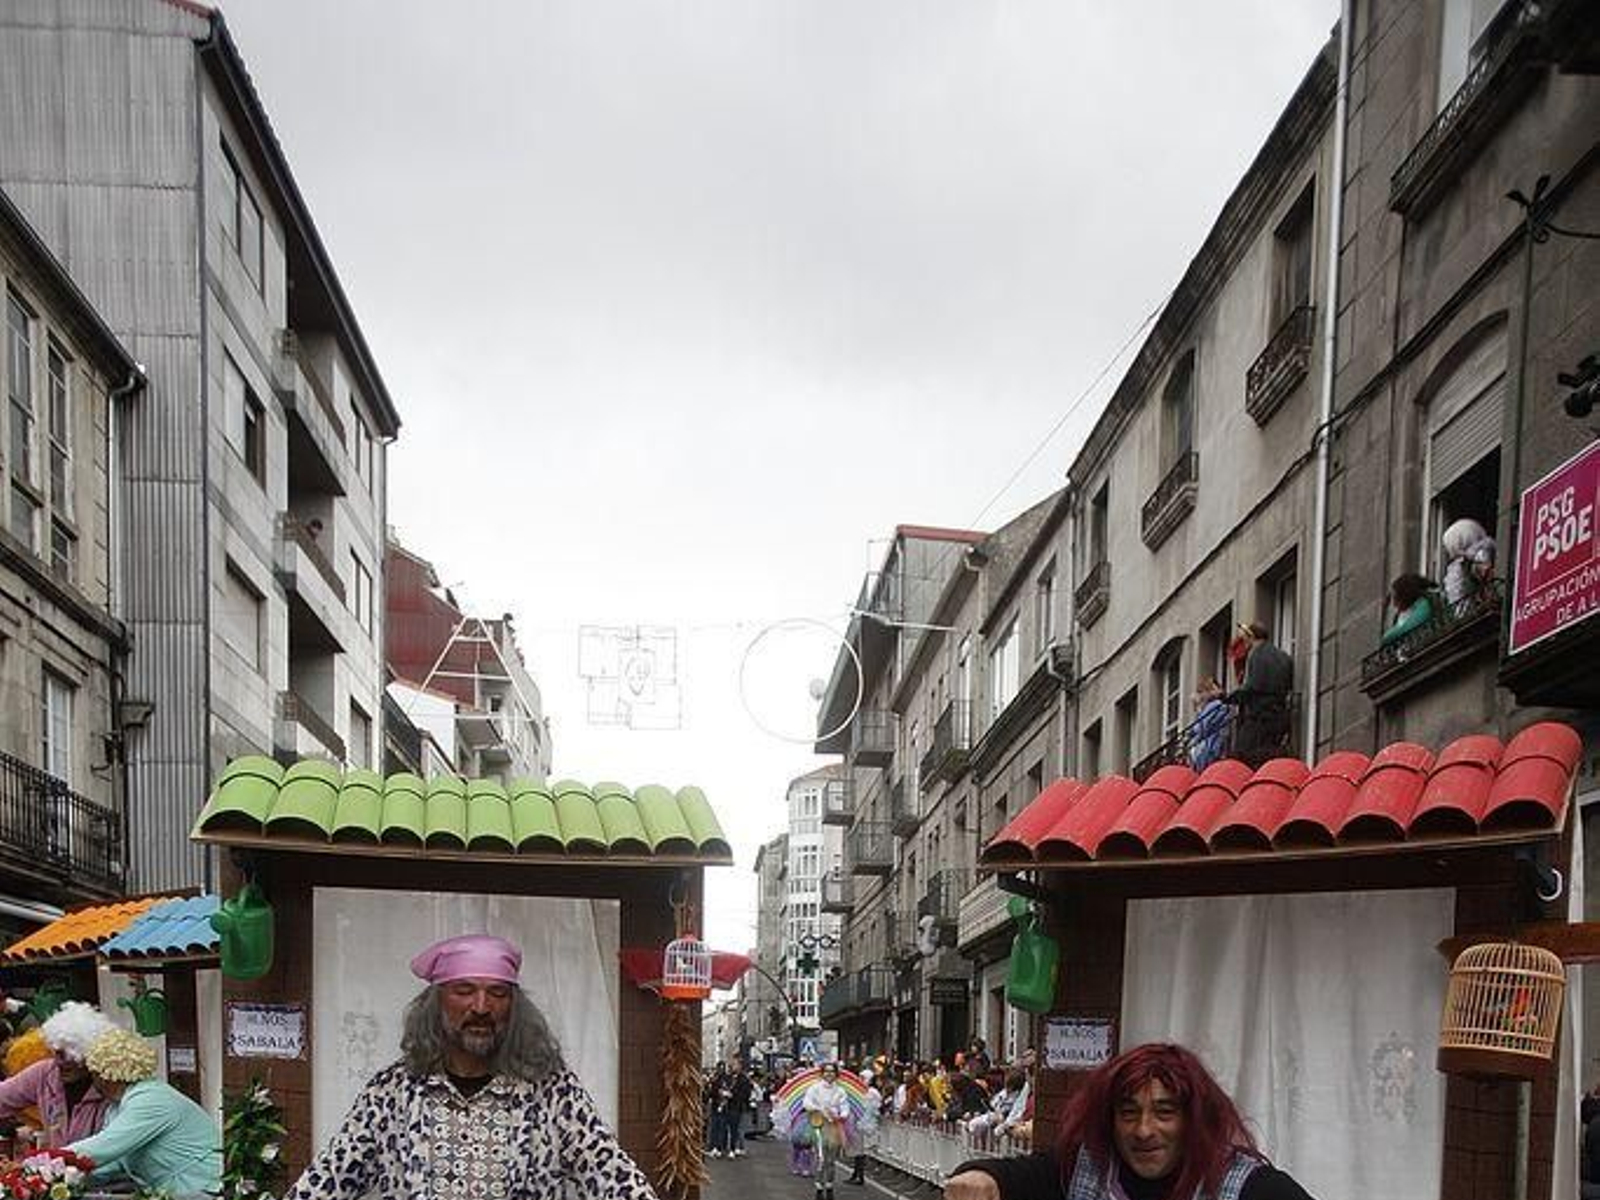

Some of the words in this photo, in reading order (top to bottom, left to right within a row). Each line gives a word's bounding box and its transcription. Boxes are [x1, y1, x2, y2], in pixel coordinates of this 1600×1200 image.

[1536, 486, 1575, 535] PSG
[1533, 505, 1593, 570] PSOE
[1556, 601, 1575, 625] DE
[237, 1034, 297, 1050] SABALA
